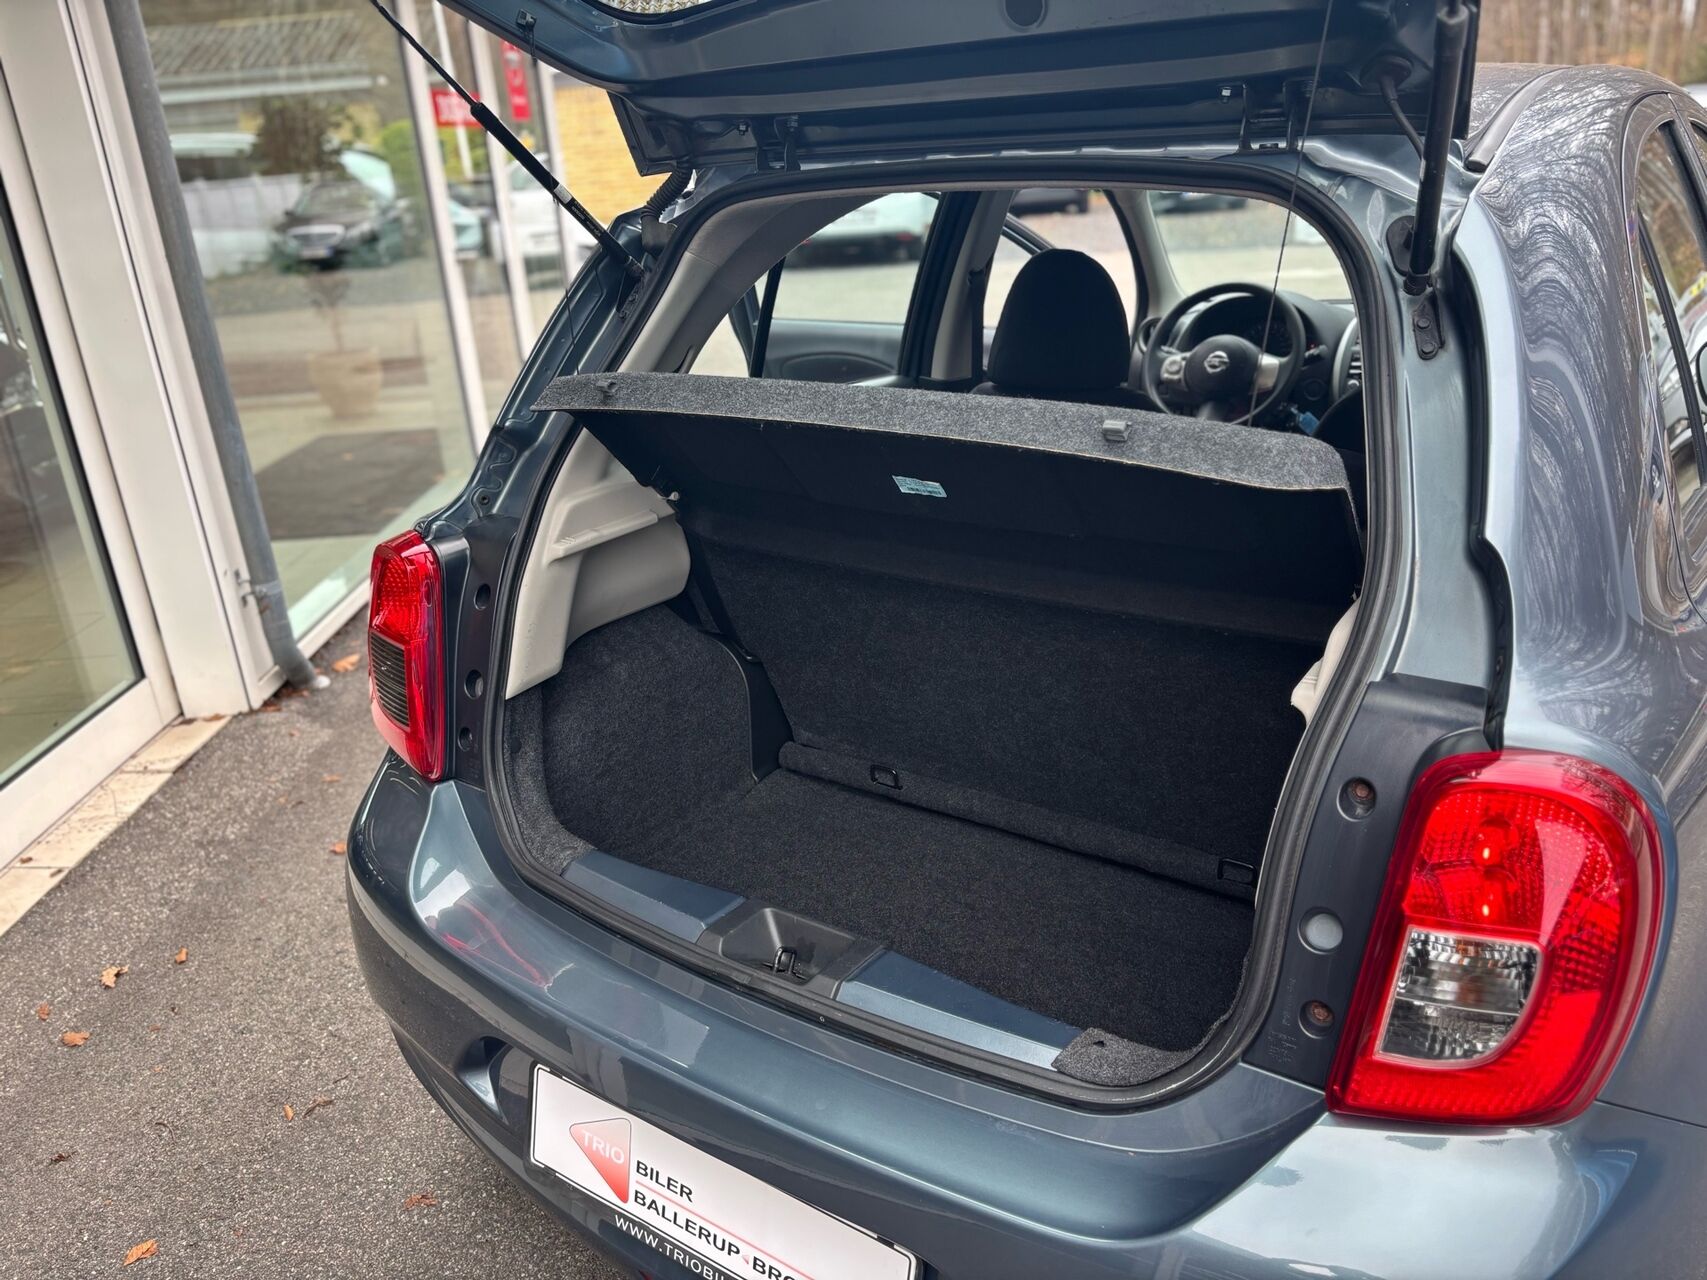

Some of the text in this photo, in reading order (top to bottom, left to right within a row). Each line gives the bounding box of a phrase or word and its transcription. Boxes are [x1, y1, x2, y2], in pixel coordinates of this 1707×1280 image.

[581, 1131, 625, 1164] TRIO
[636, 1160, 693, 1203] BILER
[634, 1190, 796, 1280] BALLERUP BR
